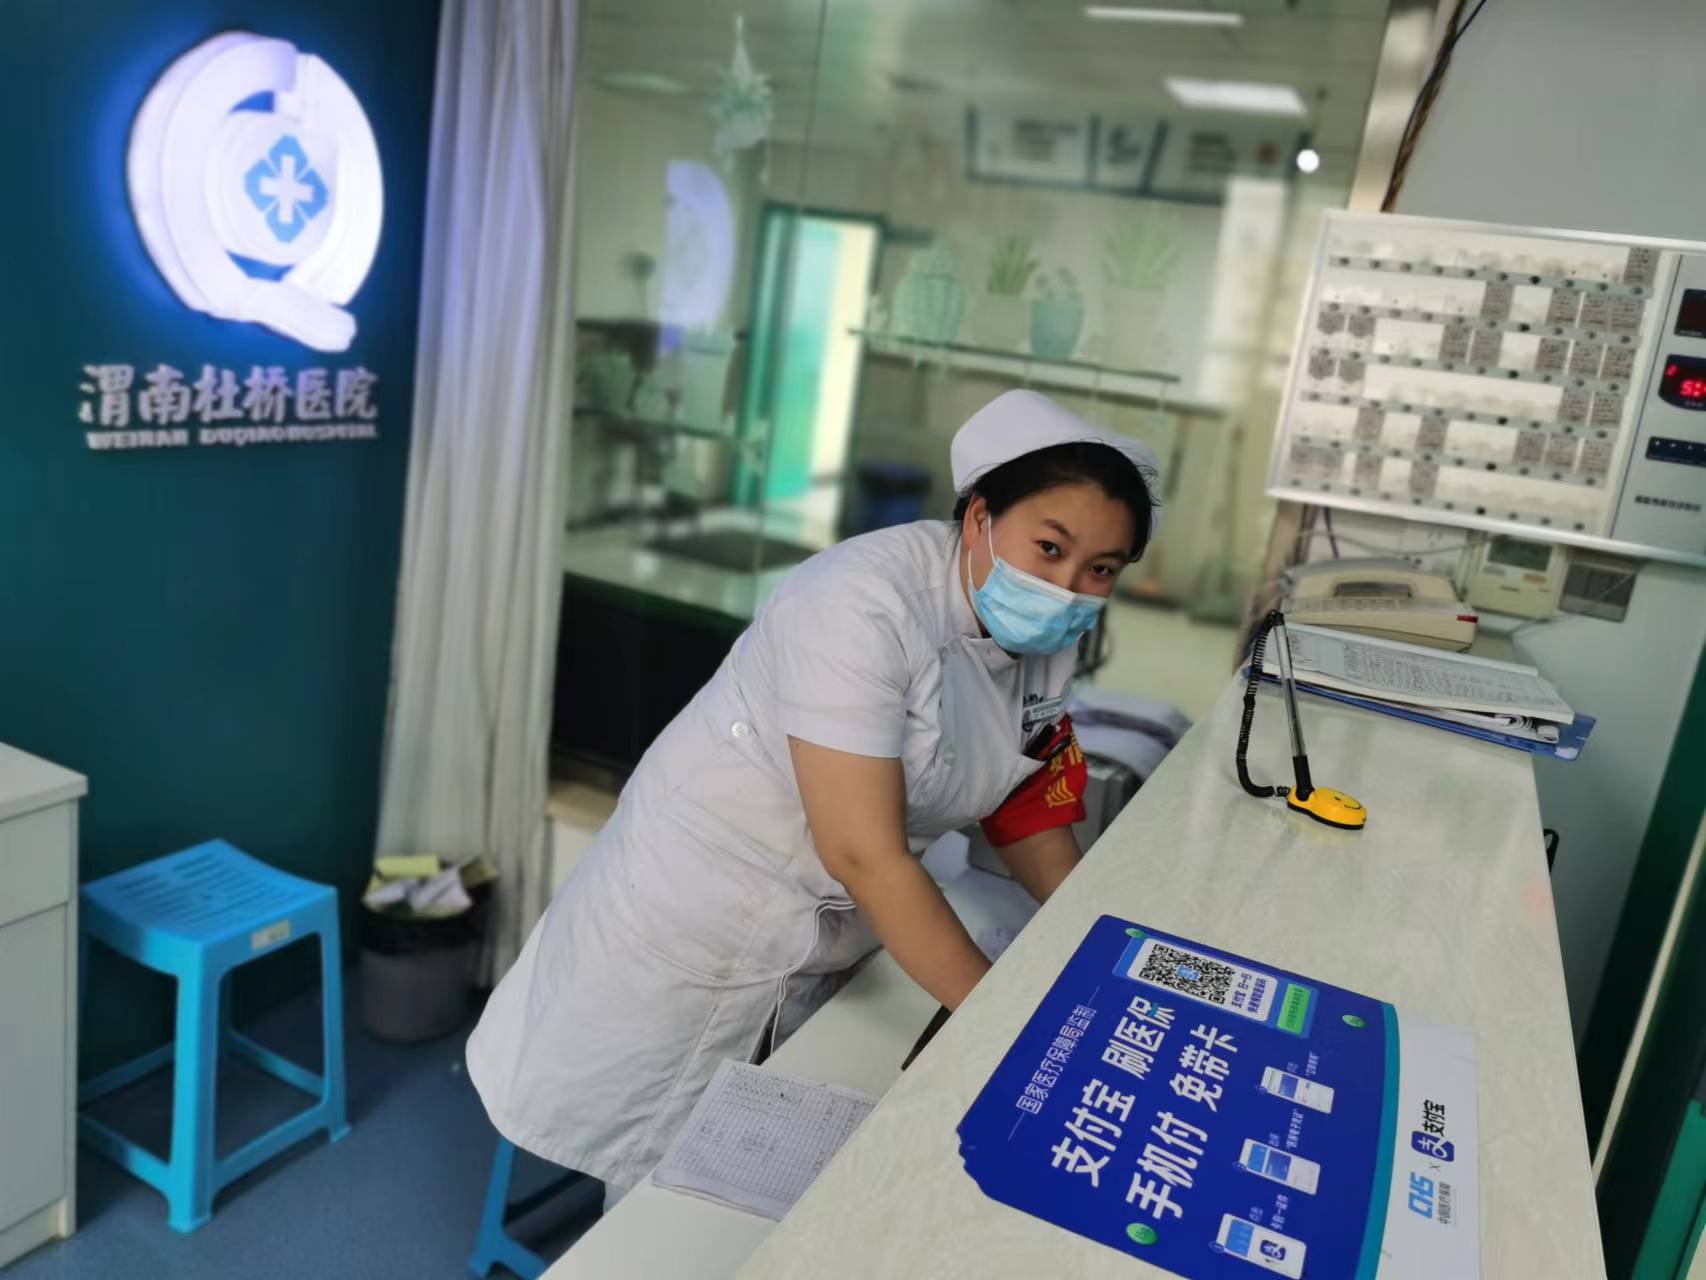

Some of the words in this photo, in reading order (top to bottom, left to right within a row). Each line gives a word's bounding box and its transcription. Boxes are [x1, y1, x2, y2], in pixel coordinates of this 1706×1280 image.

[78, 363, 378, 428] 渭南杜桥医院
[1015, 1003, 1098, 1115] 国家医疗保障局监制
[1051, 1079, 1136, 1188] 支付宝
[1101, 996, 1176, 1080] 刷医保
[1126, 1111, 1208, 1220] 手机付
[1169, 1024, 1239, 1112] 免带卡
[1422, 1099, 1447, 1136] 支付宝
